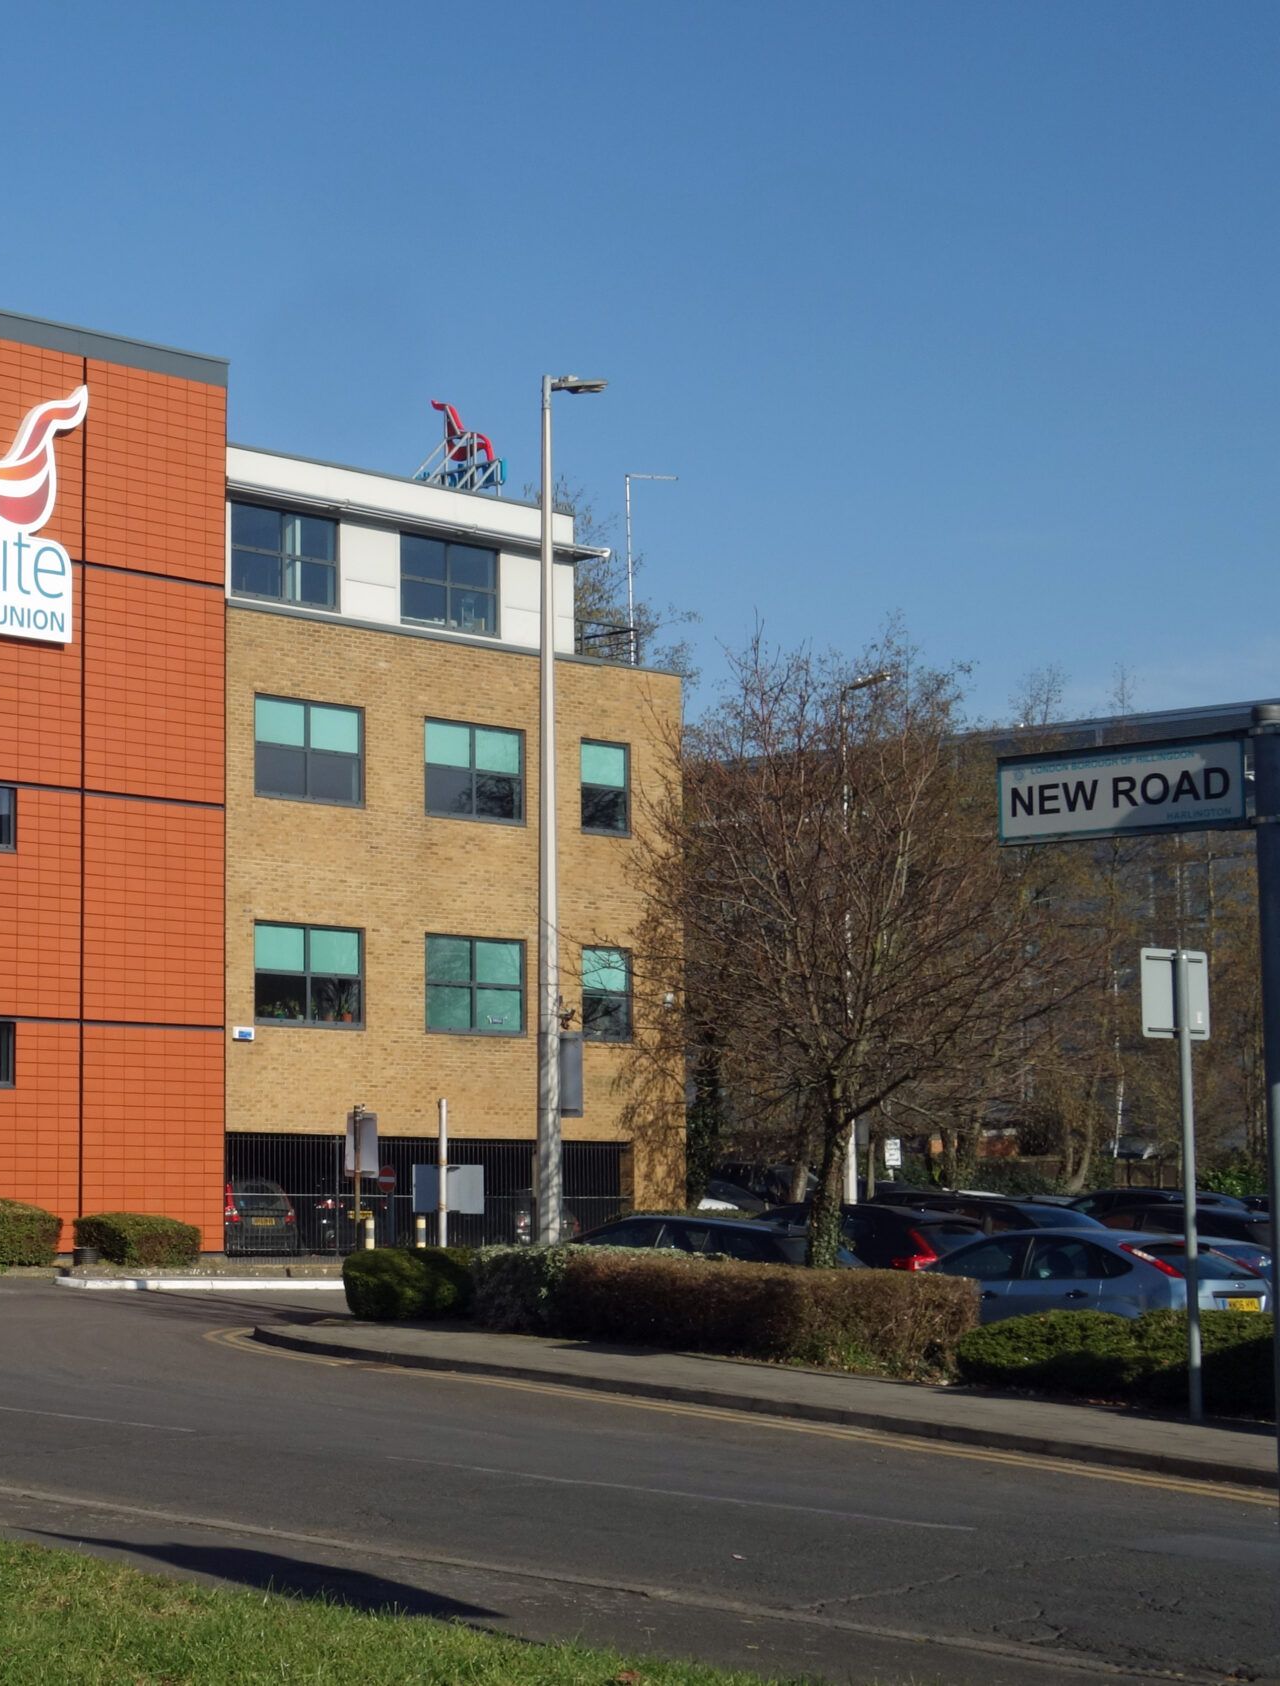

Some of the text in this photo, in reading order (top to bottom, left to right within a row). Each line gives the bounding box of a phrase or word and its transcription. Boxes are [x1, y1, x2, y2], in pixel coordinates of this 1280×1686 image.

[1030, 751, 1195, 775] LONDON BOROUGH OF HILLINGDON
[1011, 767, 1231, 818] NEW ROAD
[1167, 807, 1232, 820] HARLINGTON
